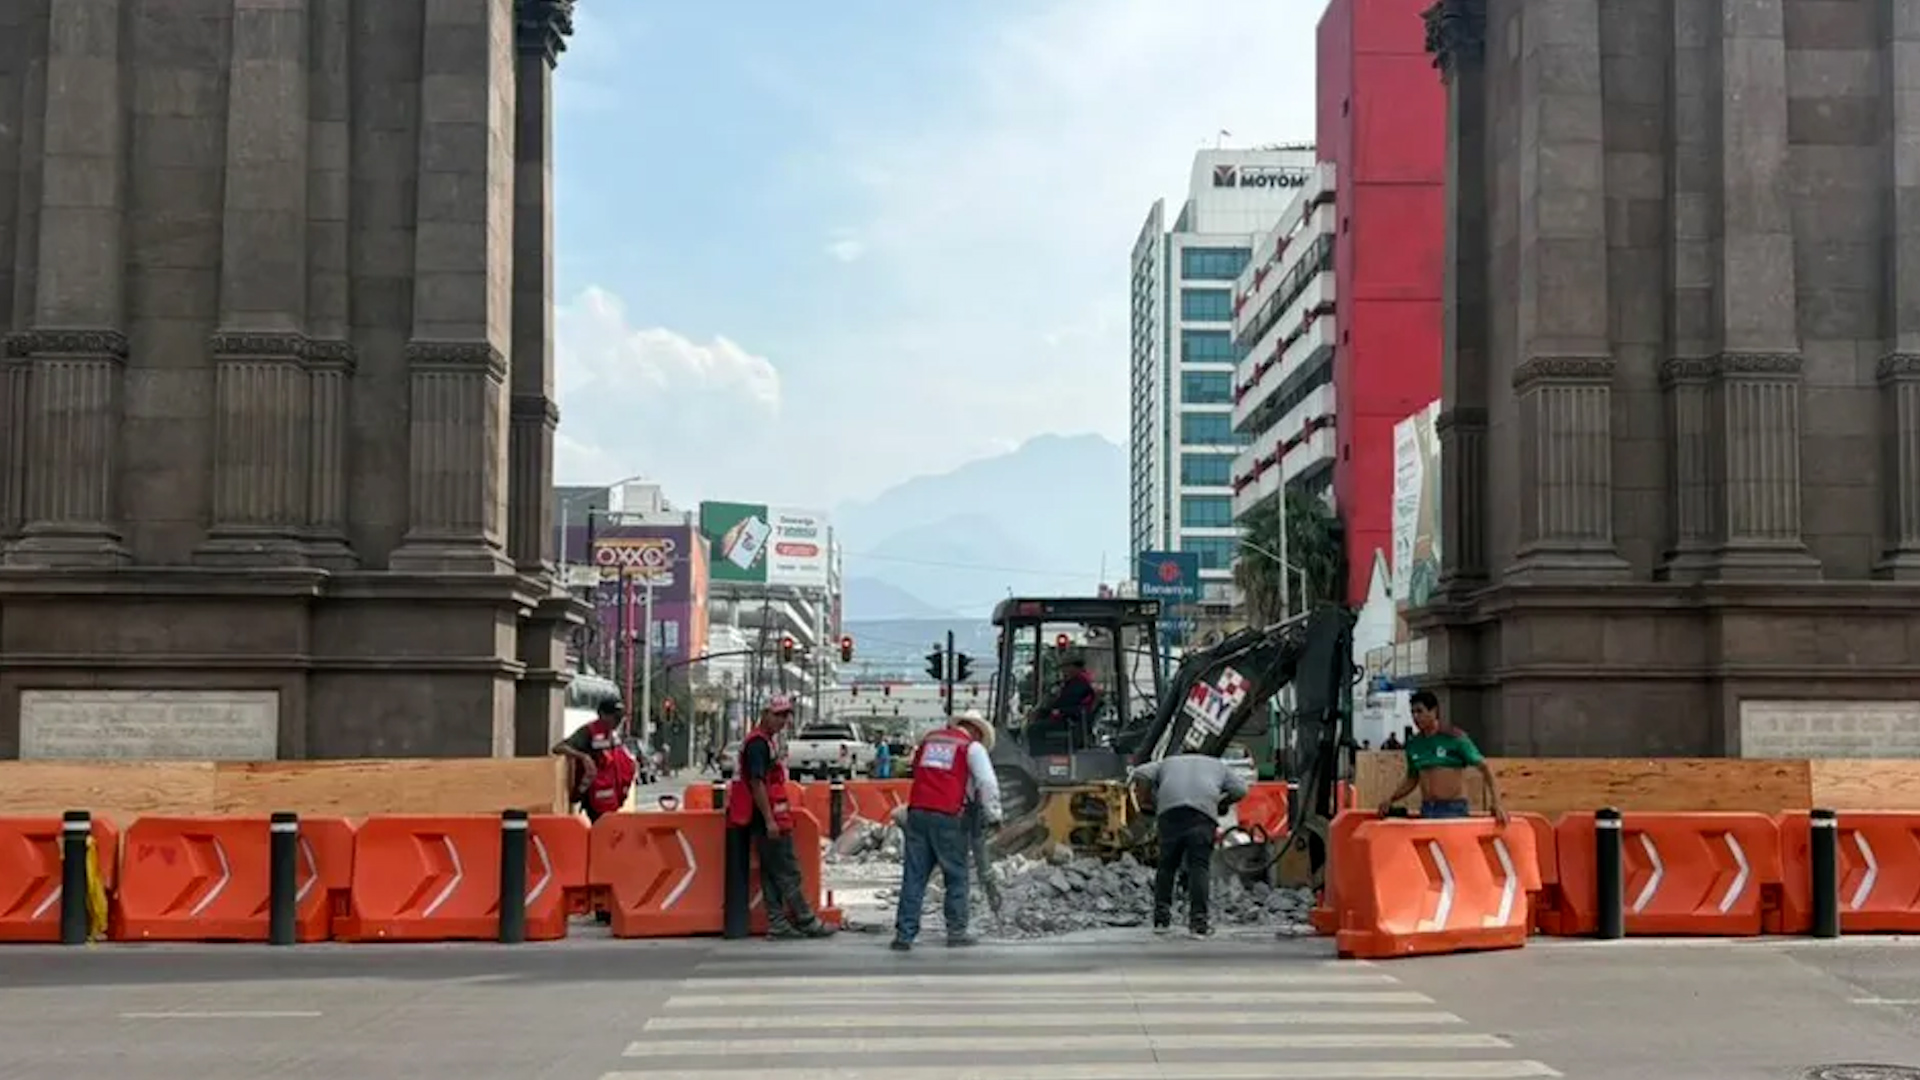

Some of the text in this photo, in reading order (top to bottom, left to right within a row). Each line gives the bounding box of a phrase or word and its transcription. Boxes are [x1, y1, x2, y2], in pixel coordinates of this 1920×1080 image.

[1240, 174, 1309, 188] MOTOM
[596, 546, 663, 565] OXXO
[1188, 681, 1231, 721] MTY
